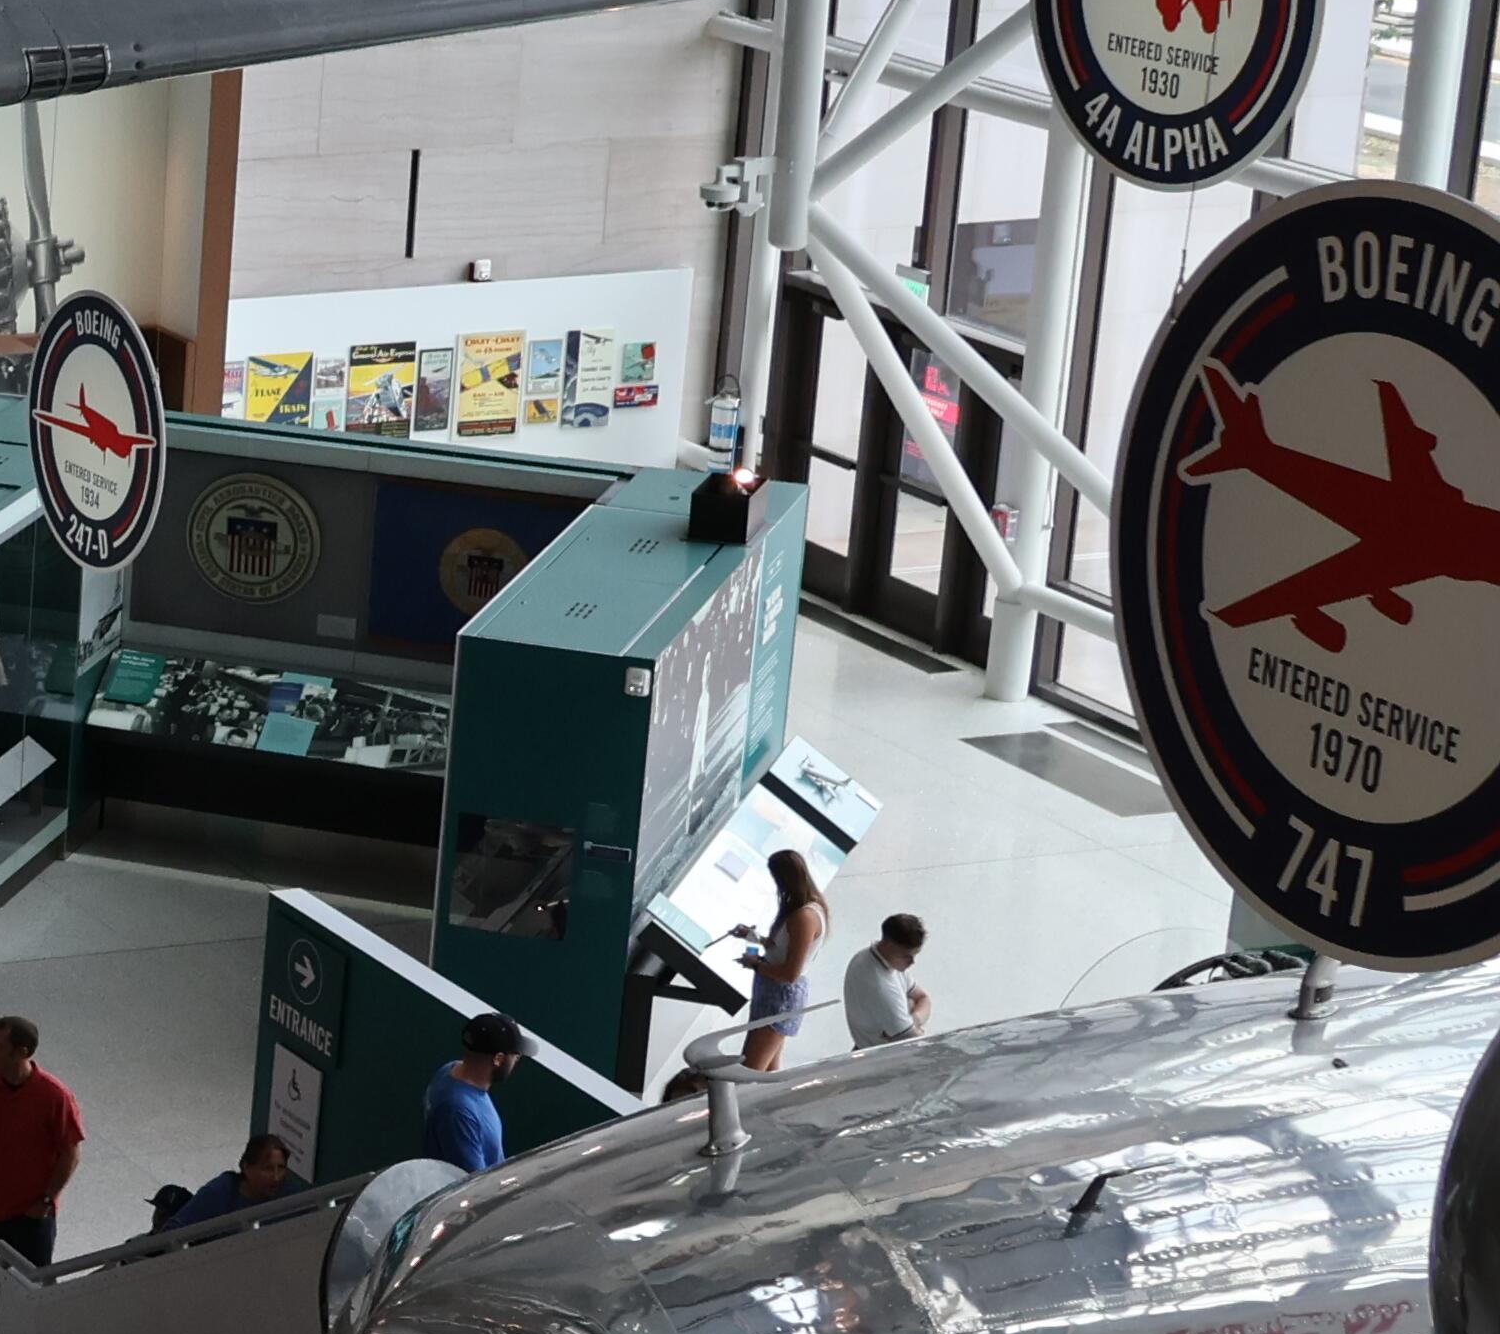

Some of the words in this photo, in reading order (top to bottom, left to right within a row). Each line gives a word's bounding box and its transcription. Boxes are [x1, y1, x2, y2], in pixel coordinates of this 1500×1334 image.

[1107, 32, 1163, 66] ENTERED
[1166, 44, 1220, 77] SERVICE
[1140, 67, 1181, 100] 1930
[1082, 93, 1118, 150] 4A
[1122, 120, 1230, 173] ALPHA
[1316, 230, 1500, 350] BOEING
[75, 310, 122, 351] BOEING
[63, 460, 90, 483] ENTERED
[91, 473, 117, 496] SERVICE
[80, 485, 100, 510] 1934
[65, 514, 109, 561] 247-D
[1249, 648, 1350, 718] ENTERED
[1358, 691, 1461, 763] SERVICE
[1309, 722, 1384, 794] 1970
[1276, 814, 1374, 928] 747
[268, 994, 334, 1058] ENTRANCE
